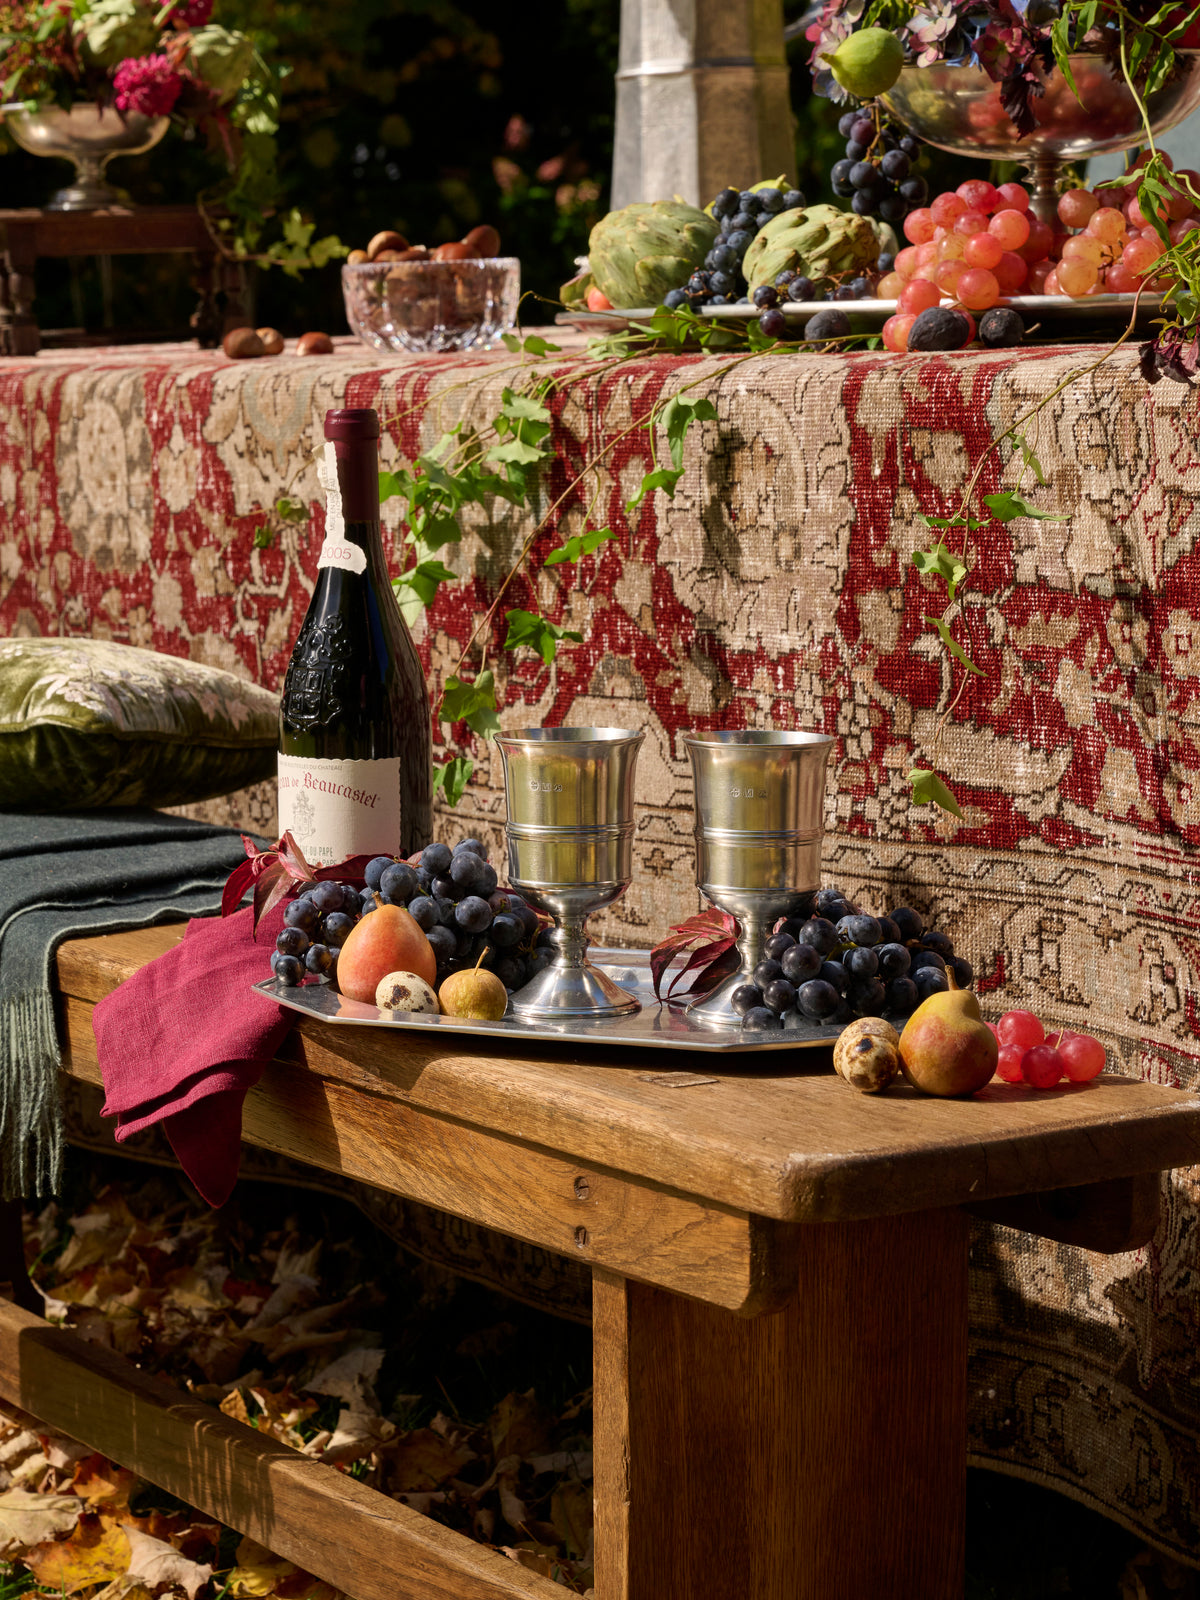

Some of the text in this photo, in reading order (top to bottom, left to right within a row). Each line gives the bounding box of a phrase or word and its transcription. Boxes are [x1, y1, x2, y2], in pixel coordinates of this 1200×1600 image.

[321, 547, 352, 560] 2005
[291, 777, 299, 788] de
[302, 770, 376, 808] Beaucastel
[318, 846, 333, 857] PAPE
